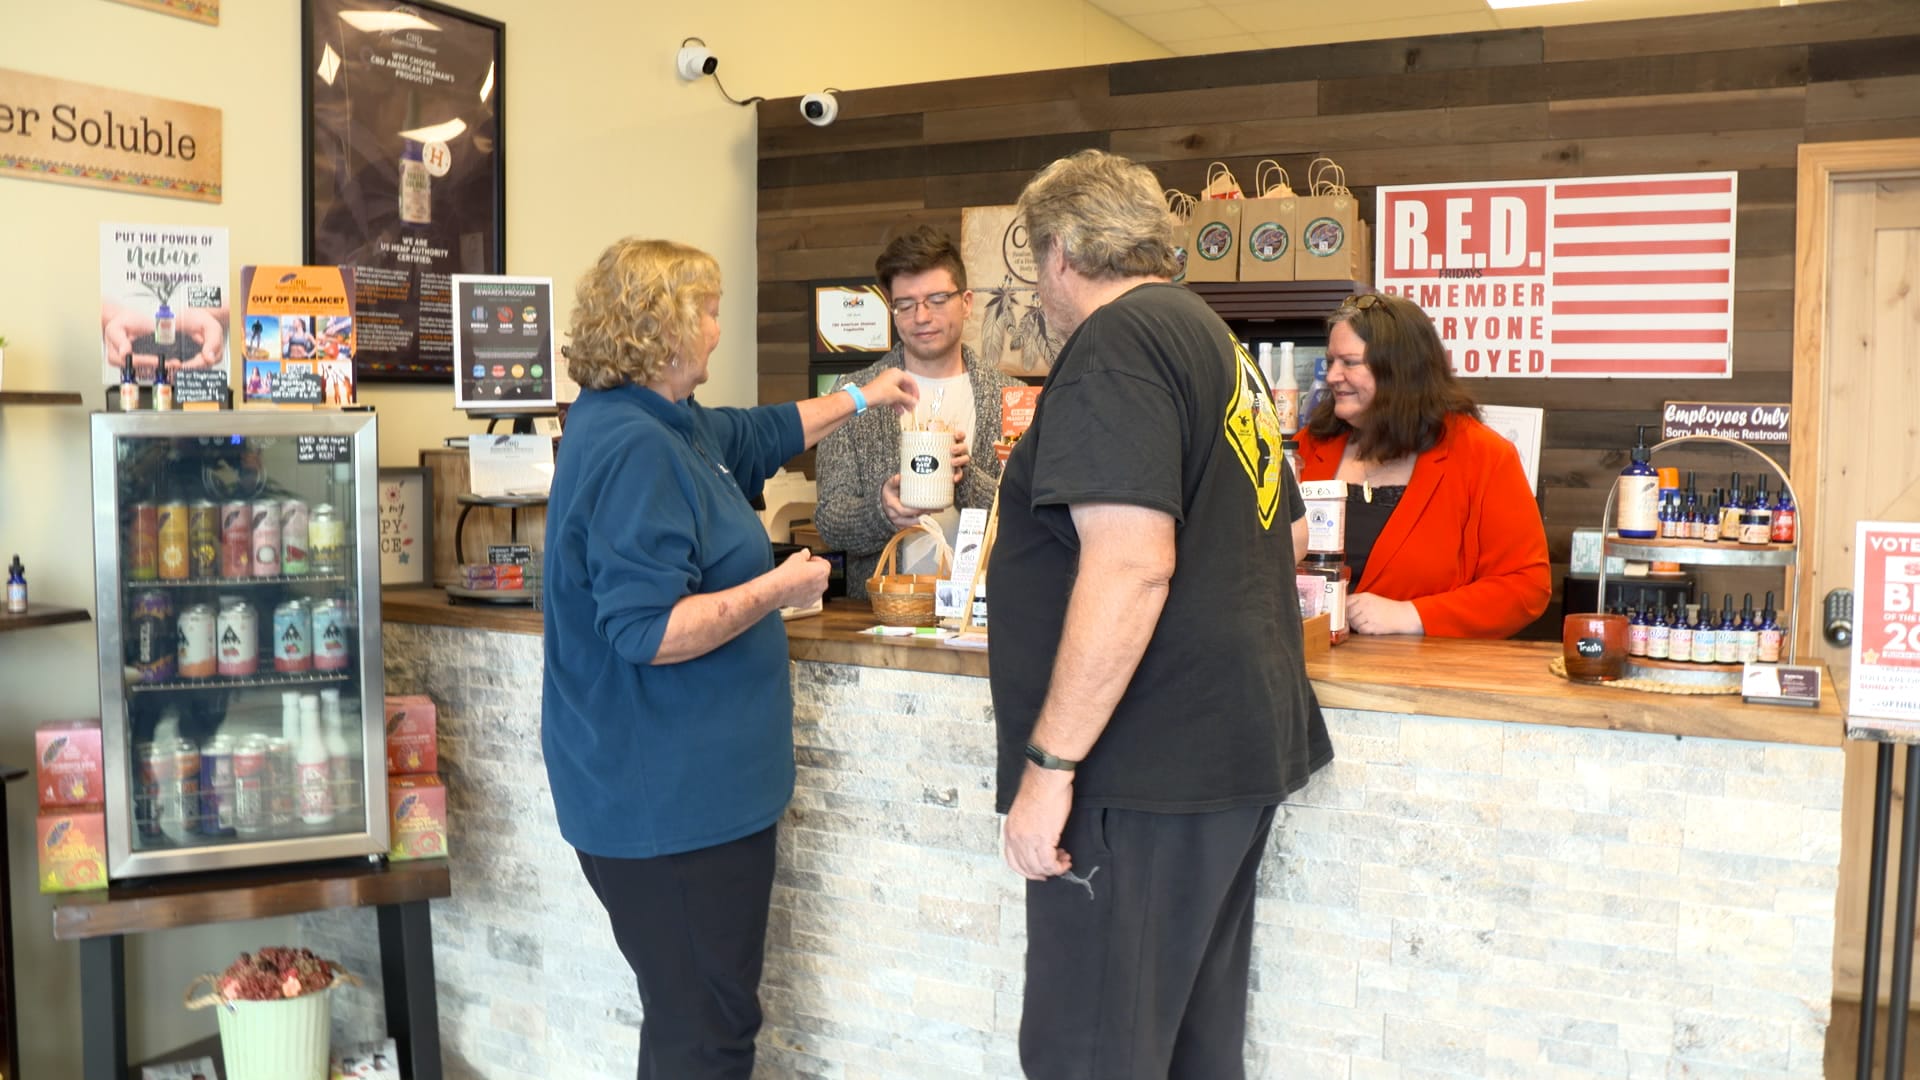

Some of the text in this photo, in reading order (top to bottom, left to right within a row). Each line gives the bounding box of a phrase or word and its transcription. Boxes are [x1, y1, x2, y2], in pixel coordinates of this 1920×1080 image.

[392, 51, 436, 69] WHY CHOOSE
[370, 55, 455, 83] CBD AMERICAN SHAMAN'S
[395, 70, 433, 86] PRODUCTS?
[0, 104, 196, 161] er Soluble
[430, 147, 445, 168] H
[115, 231, 212, 246] PUT THE POWER OF
[402, 236, 428, 247] WE ARE
[1394, 196, 1542, 271] R.E.D.
[127, 246, 201, 269] Nature
[380, 242, 448, 259] US HEMP AUTHORITY
[397, 253, 433, 265] CERTIFIED.
[126, 271, 203, 283] IN YOUR HANDS
[1438, 268, 1483, 279] FRIDAYS
[252, 295, 344, 305] OUT OF BALANCE?
[473, 289, 536, 297] REWARDS PROGRAM
[1432, 316, 1544, 340] RYONE
[1664, 404, 1790, 429] Employees Only
[1695, 428, 1709, 436] No
[1710, 428, 1740, 439] Public
[1742, 428, 1788, 440] Restroom
[381, 519, 401, 535] PY
[381, 538, 401, 553] CE
[1870, 535, 1920, 552] VOTE
[1884, 612, 1915, 622] OF THE
[1576, 640, 1602, 653] Trash
